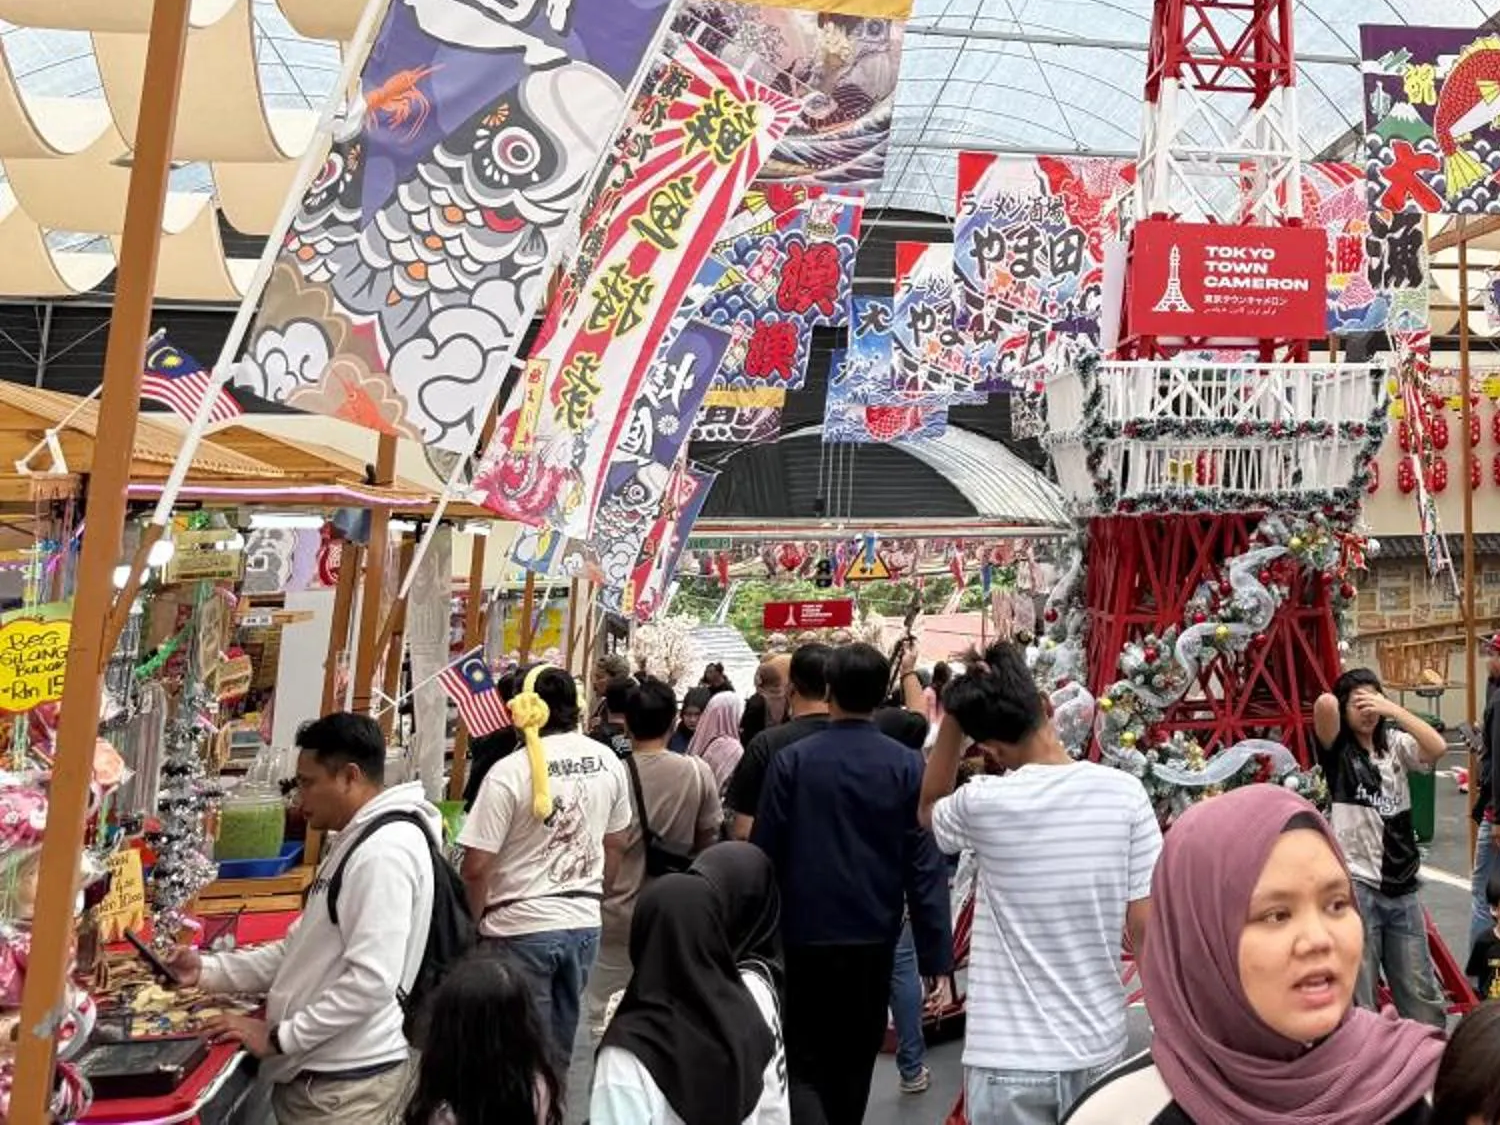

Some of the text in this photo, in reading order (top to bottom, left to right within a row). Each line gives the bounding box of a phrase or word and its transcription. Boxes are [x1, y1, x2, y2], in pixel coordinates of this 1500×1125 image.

[1379, 139, 1443, 213] 大
[969, 224, 1087, 279] やま田
[1204, 246, 1275, 260] TOKYO
[1204, 260, 1268, 274] TOWN
[1203, 275, 1309, 291] CAMERON
